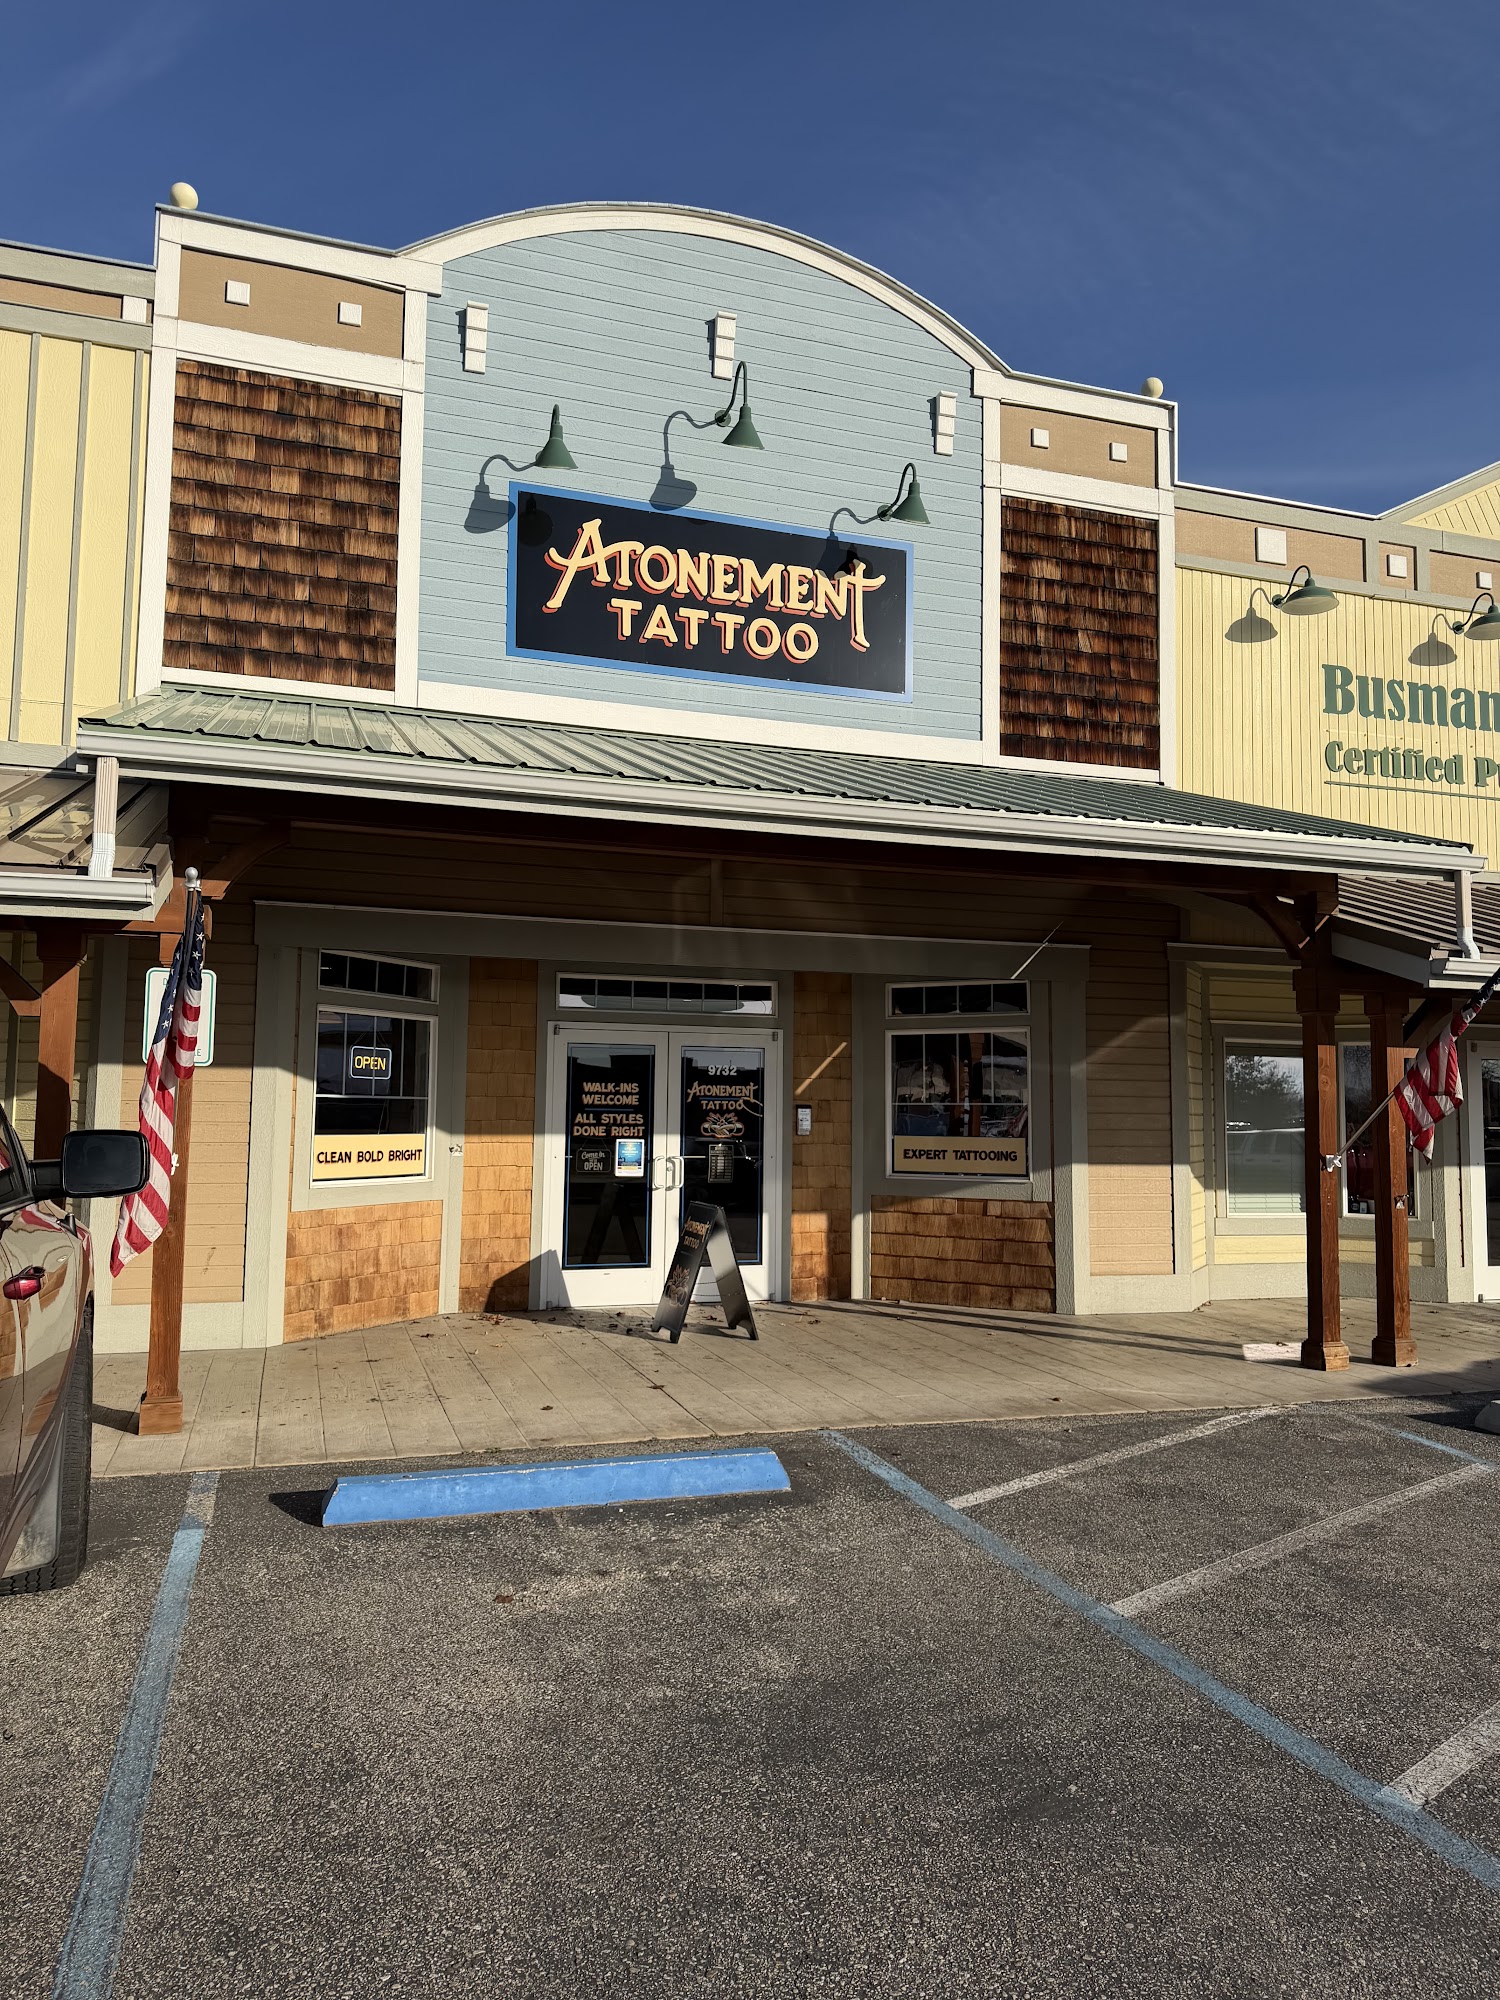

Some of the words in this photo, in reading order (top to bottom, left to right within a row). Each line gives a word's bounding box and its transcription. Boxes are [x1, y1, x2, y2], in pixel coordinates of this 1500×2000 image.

[543, 518, 886, 653] ATONEMENT
[606, 598, 819, 664] TATTOO
[1325, 741, 1465, 785] Certified
[1474, 757, 1500, 787] P
[354, 1055, 386, 1071] OPEN
[708, 1064, 737, 1076] 9732
[583, 1082, 639, 1093] WALK-INS
[686, 1081, 758, 1103] ATONEMENT
[582, 1094, 639, 1105] WELCOME
[701, 1100, 744, 1110] TATTOO
[574, 1112, 596, 1124] ALL
[601, 1113, 644, 1125] STYLES
[573, 1125, 606, 1137] DONE
[611, 1126, 645, 1137] RIGHT
[317, 1151, 351, 1163] CLEAN
[357, 1150, 383, 1163] BOLD
[388, 1149, 422, 1161] BRIGHT
[904, 1149, 948, 1160] EXPERT
[953, 1149, 1018, 1162] TATTOOING
[584, 1161, 603, 1171] OPEN
